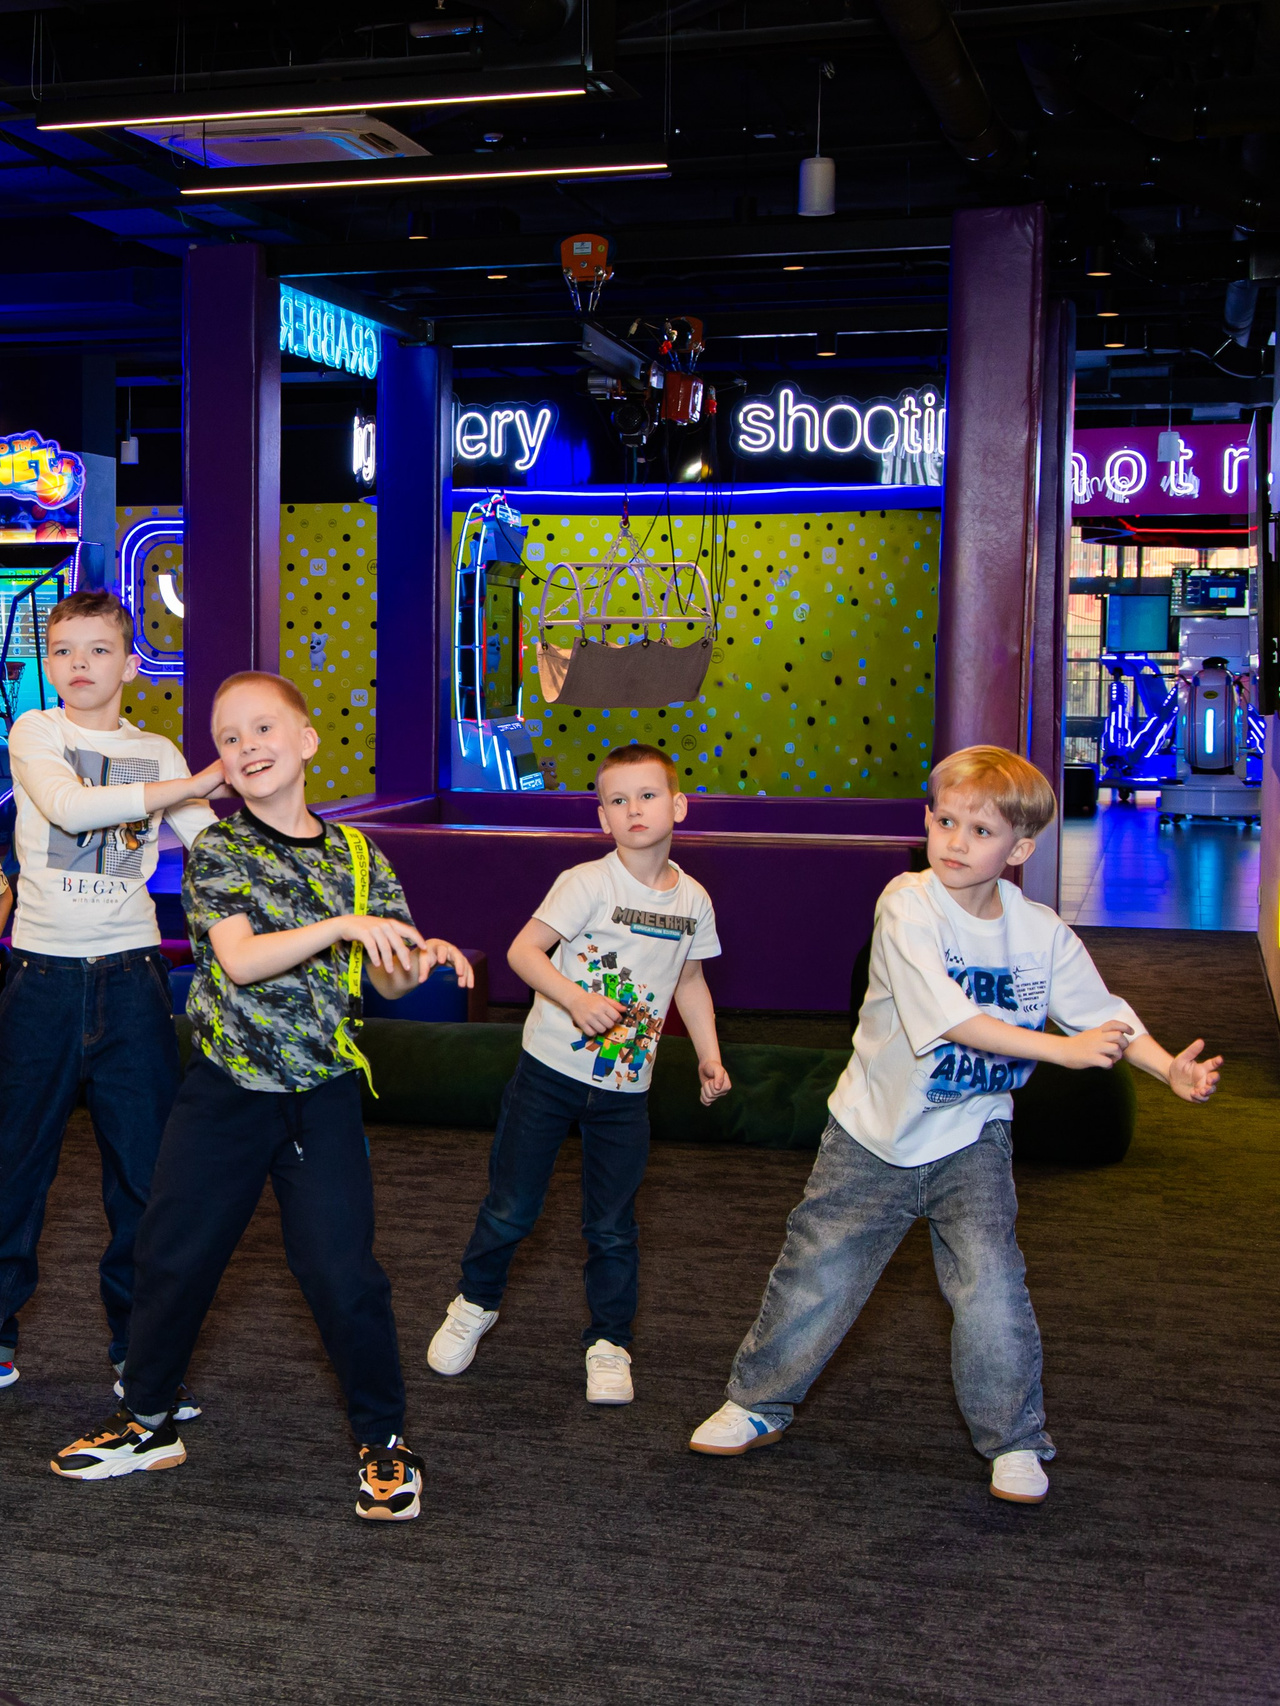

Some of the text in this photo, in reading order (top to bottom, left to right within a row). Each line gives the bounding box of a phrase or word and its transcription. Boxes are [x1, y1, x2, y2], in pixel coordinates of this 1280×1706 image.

[455, 407, 552, 471] ery
[611, 905, 698, 936] MINECRAFT
[633, 924, 662, 934] EDUCATION
[929, 1053, 1020, 1092] APART
